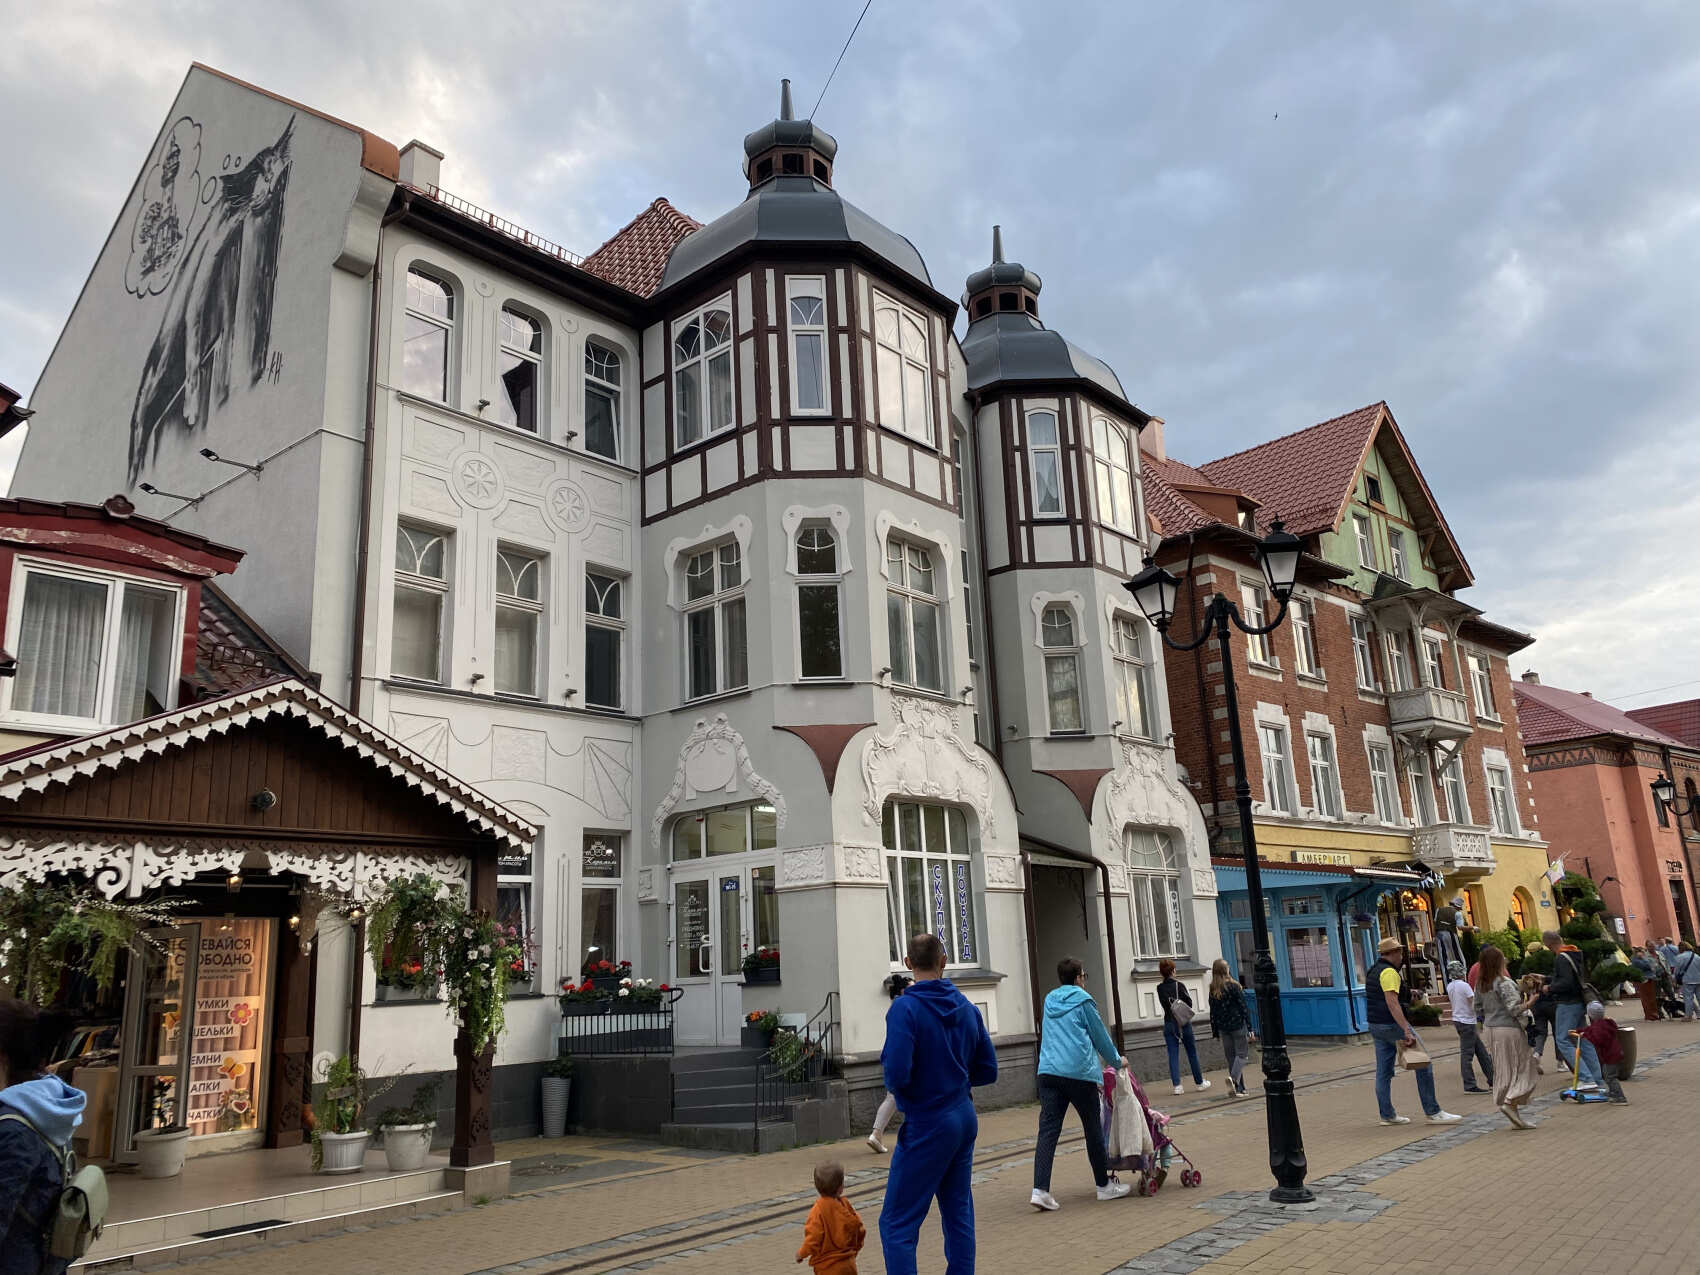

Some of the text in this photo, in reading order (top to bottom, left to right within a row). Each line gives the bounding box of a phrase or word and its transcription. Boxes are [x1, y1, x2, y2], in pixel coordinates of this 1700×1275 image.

[957, 865, 971, 960] ЛОМБАРД
[197, 999, 229, 1009] УМКИ
[190, 1081, 220, 1093] АПКИ
